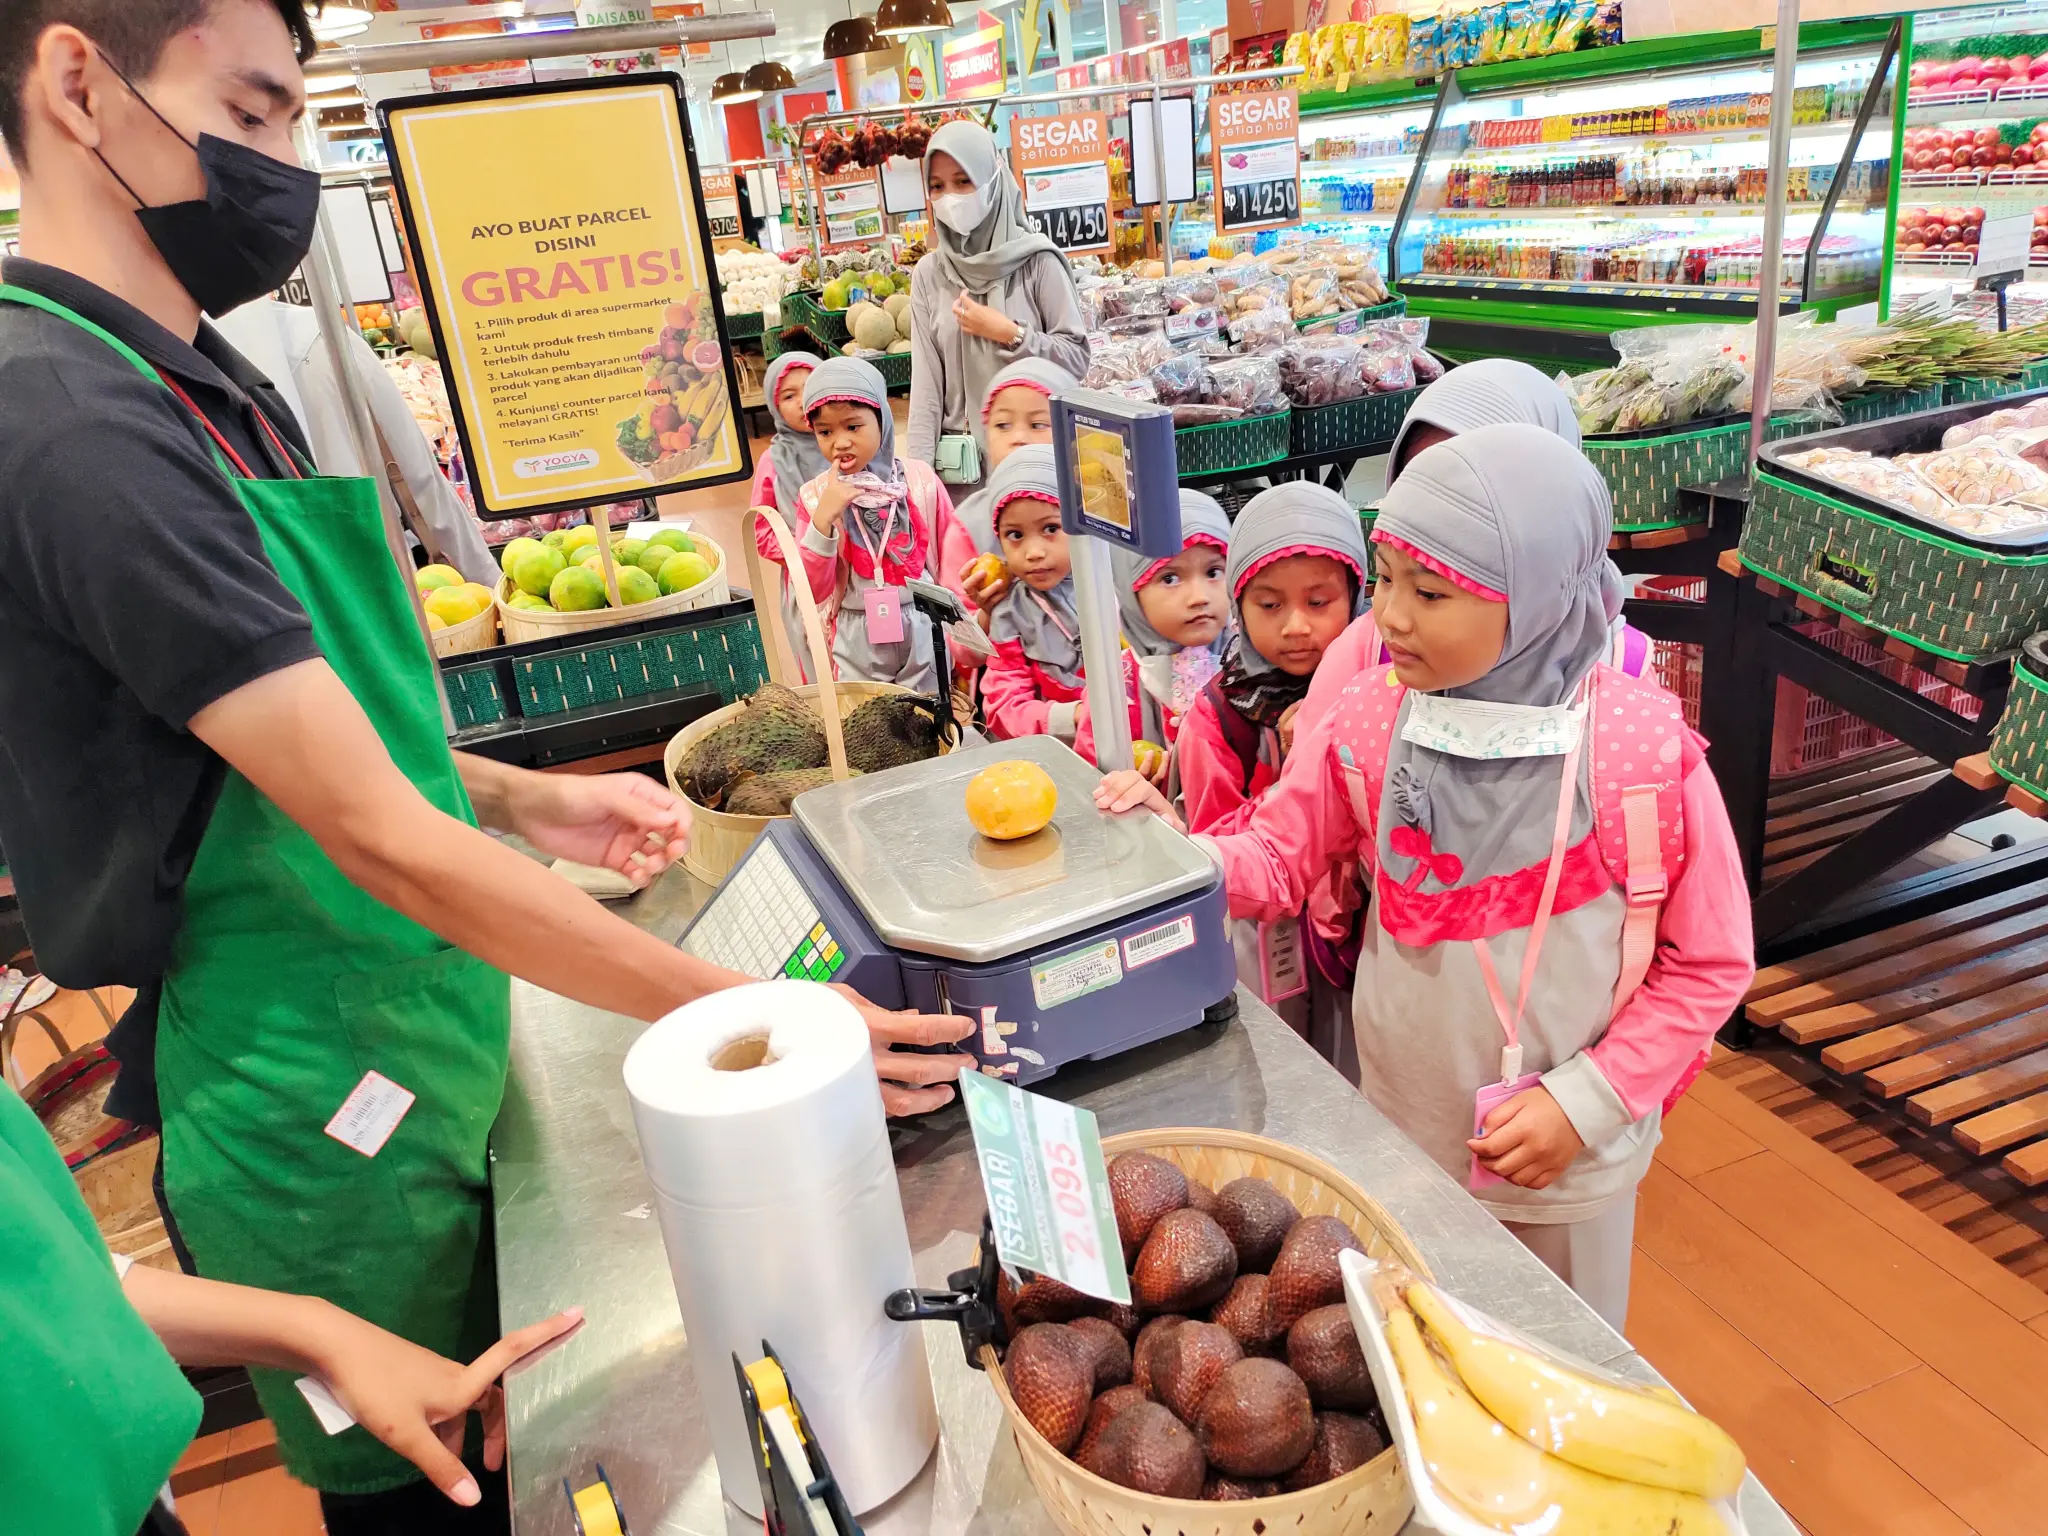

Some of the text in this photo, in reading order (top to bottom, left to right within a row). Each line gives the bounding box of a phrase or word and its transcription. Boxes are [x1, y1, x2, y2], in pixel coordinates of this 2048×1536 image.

[586, 9, 646, 25] DAISABU
[1219, 96, 1291, 126] SEGAR
[1019, 118, 1098, 149] SEGAR
[1220, 119, 1293, 137] setiap hari
[1021, 141, 1100, 160] setiap hari
[1223, 181, 1297, 218] Rp 14250
[471, 207, 651, 239] AYO BUAT PARCEL
[1028, 206, 1107, 243] Rp 14250
[535, 234, 596, 254] DISINI
[461, 248, 684, 307] GRATIS!
[475, 297, 672, 329] 1. Pilih produk di area supermarket
[477, 330, 506, 341] kami
[481, 325, 654, 356] 2. Untuk produk fresh timbang
[483, 348, 570, 367] terlebih dahulu
[487, 351, 656, 381] 3. Lakukan pembayaran untuk
[490, 365, 643, 394] produk yang akan dijadikan
[493, 393, 527, 405] parcel
[496, 409, 507, 418] 4.
[509, 402, 560, 417] Kunjungi
[563, 397, 606, 408] counter
[608, 391, 642, 403] parcel
[499, 408, 599, 429] melayani GRATIS!
[986, 1154, 1026, 1252] SEGAR
[1044, 1139, 1096, 1260] 2.095
